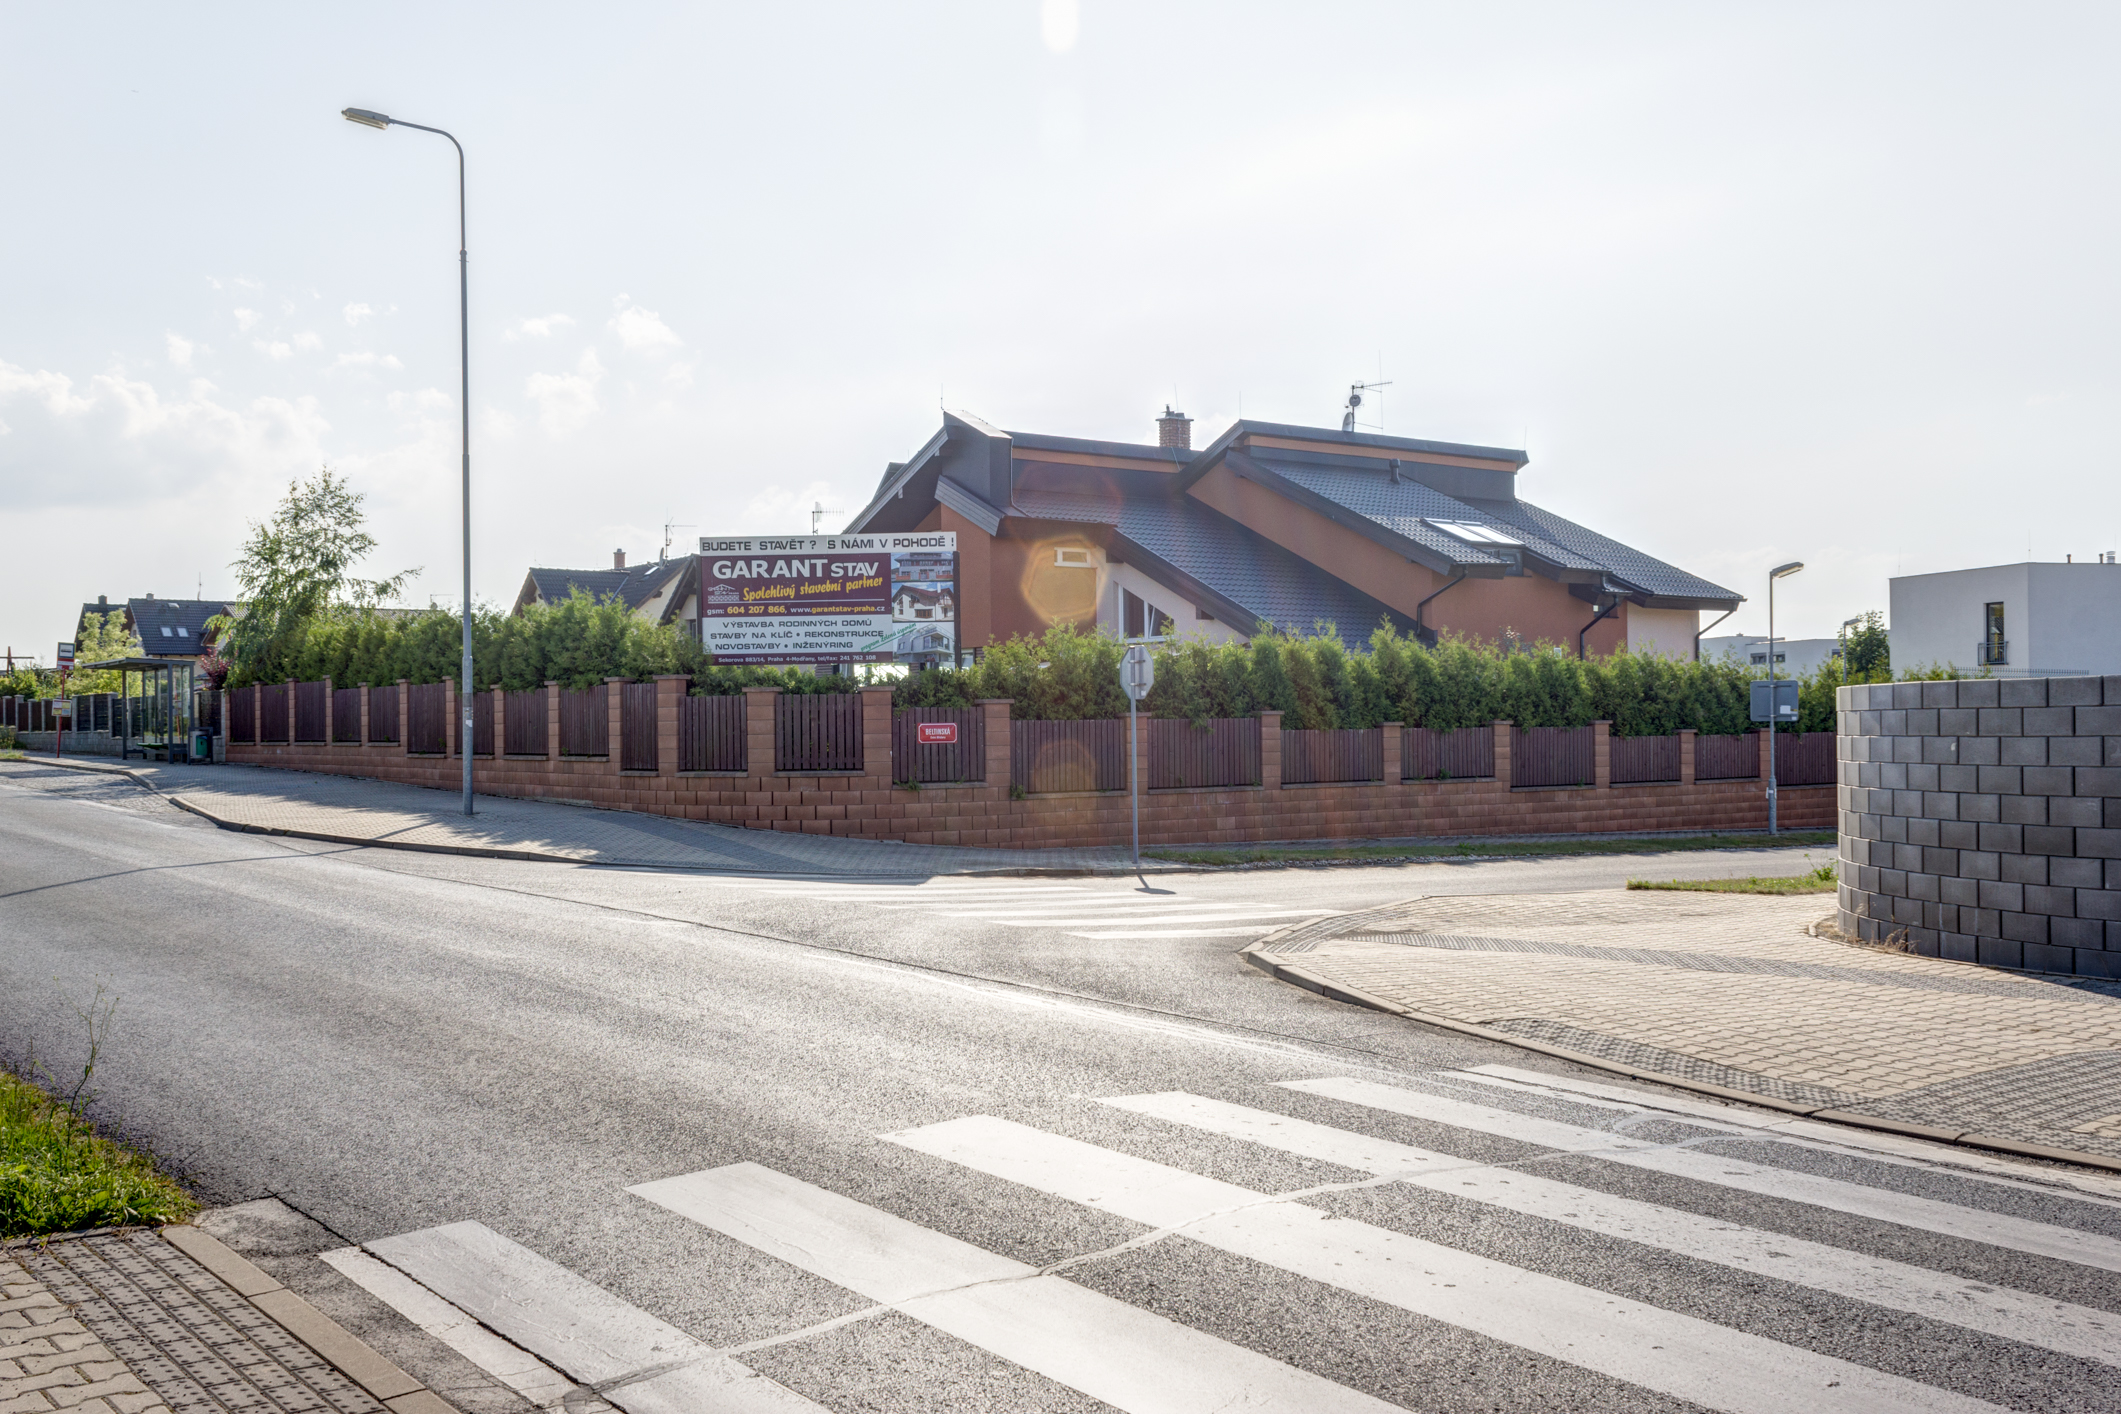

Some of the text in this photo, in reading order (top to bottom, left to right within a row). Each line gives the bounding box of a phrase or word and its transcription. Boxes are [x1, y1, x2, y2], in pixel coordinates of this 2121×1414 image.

[702, 541, 752, 551] BUDETE
[759, 539, 805, 550] STAVĚT
[827, 540, 836, 549] S
[841, 537, 874, 549] NÁMI
[879, 539, 888, 549] V
[893, 535, 946, 548] POHODĚ
[712, 559, 880, 579] GARANT STAV
[743, 584, 796, 603] Spolehlivý
[800, 580, 842, 595] stavební
[846, 576, 883, 593] partner
[727, 606, 745, 614] 604
[748, 605, 765, 614] 207
[768, 605, 788, 615] 866,
[790, 605, 885, 613] www.garantstav-praha.cz
[779, 619, 837, 627] RODINNÝCH
[710, 632, 748, 640] STAVBY
[770, 630, 793, 639] KLÍČ
[715, 641, 853, 650] NOVOSTAVBY INŽENÝRING
